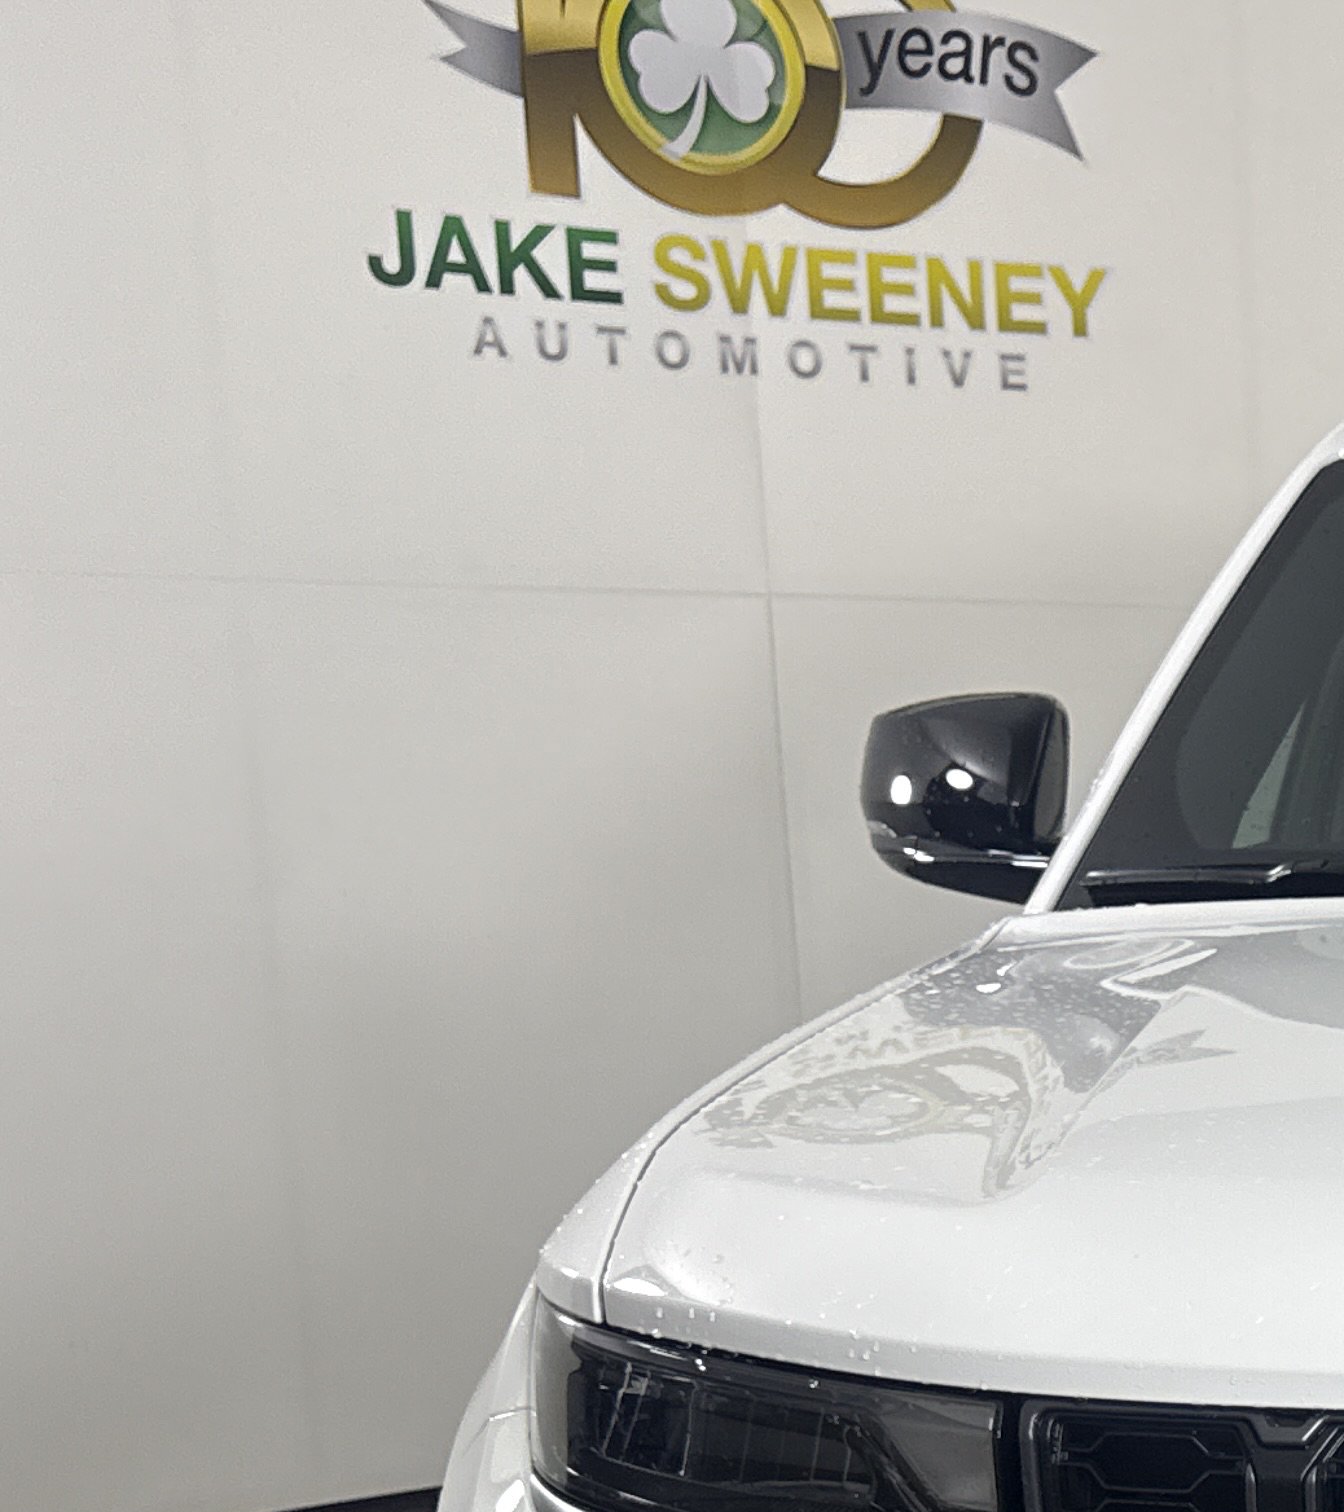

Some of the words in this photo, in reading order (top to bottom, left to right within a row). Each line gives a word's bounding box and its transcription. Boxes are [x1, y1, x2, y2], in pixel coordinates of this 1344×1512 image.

[857, 24, 1040, 97] years
[367, 209, 624, 305] JAKE
[652, 233, 1107, 338] SWEENEY
[473, 316, 1029, 392] AUTOMOTIVE
